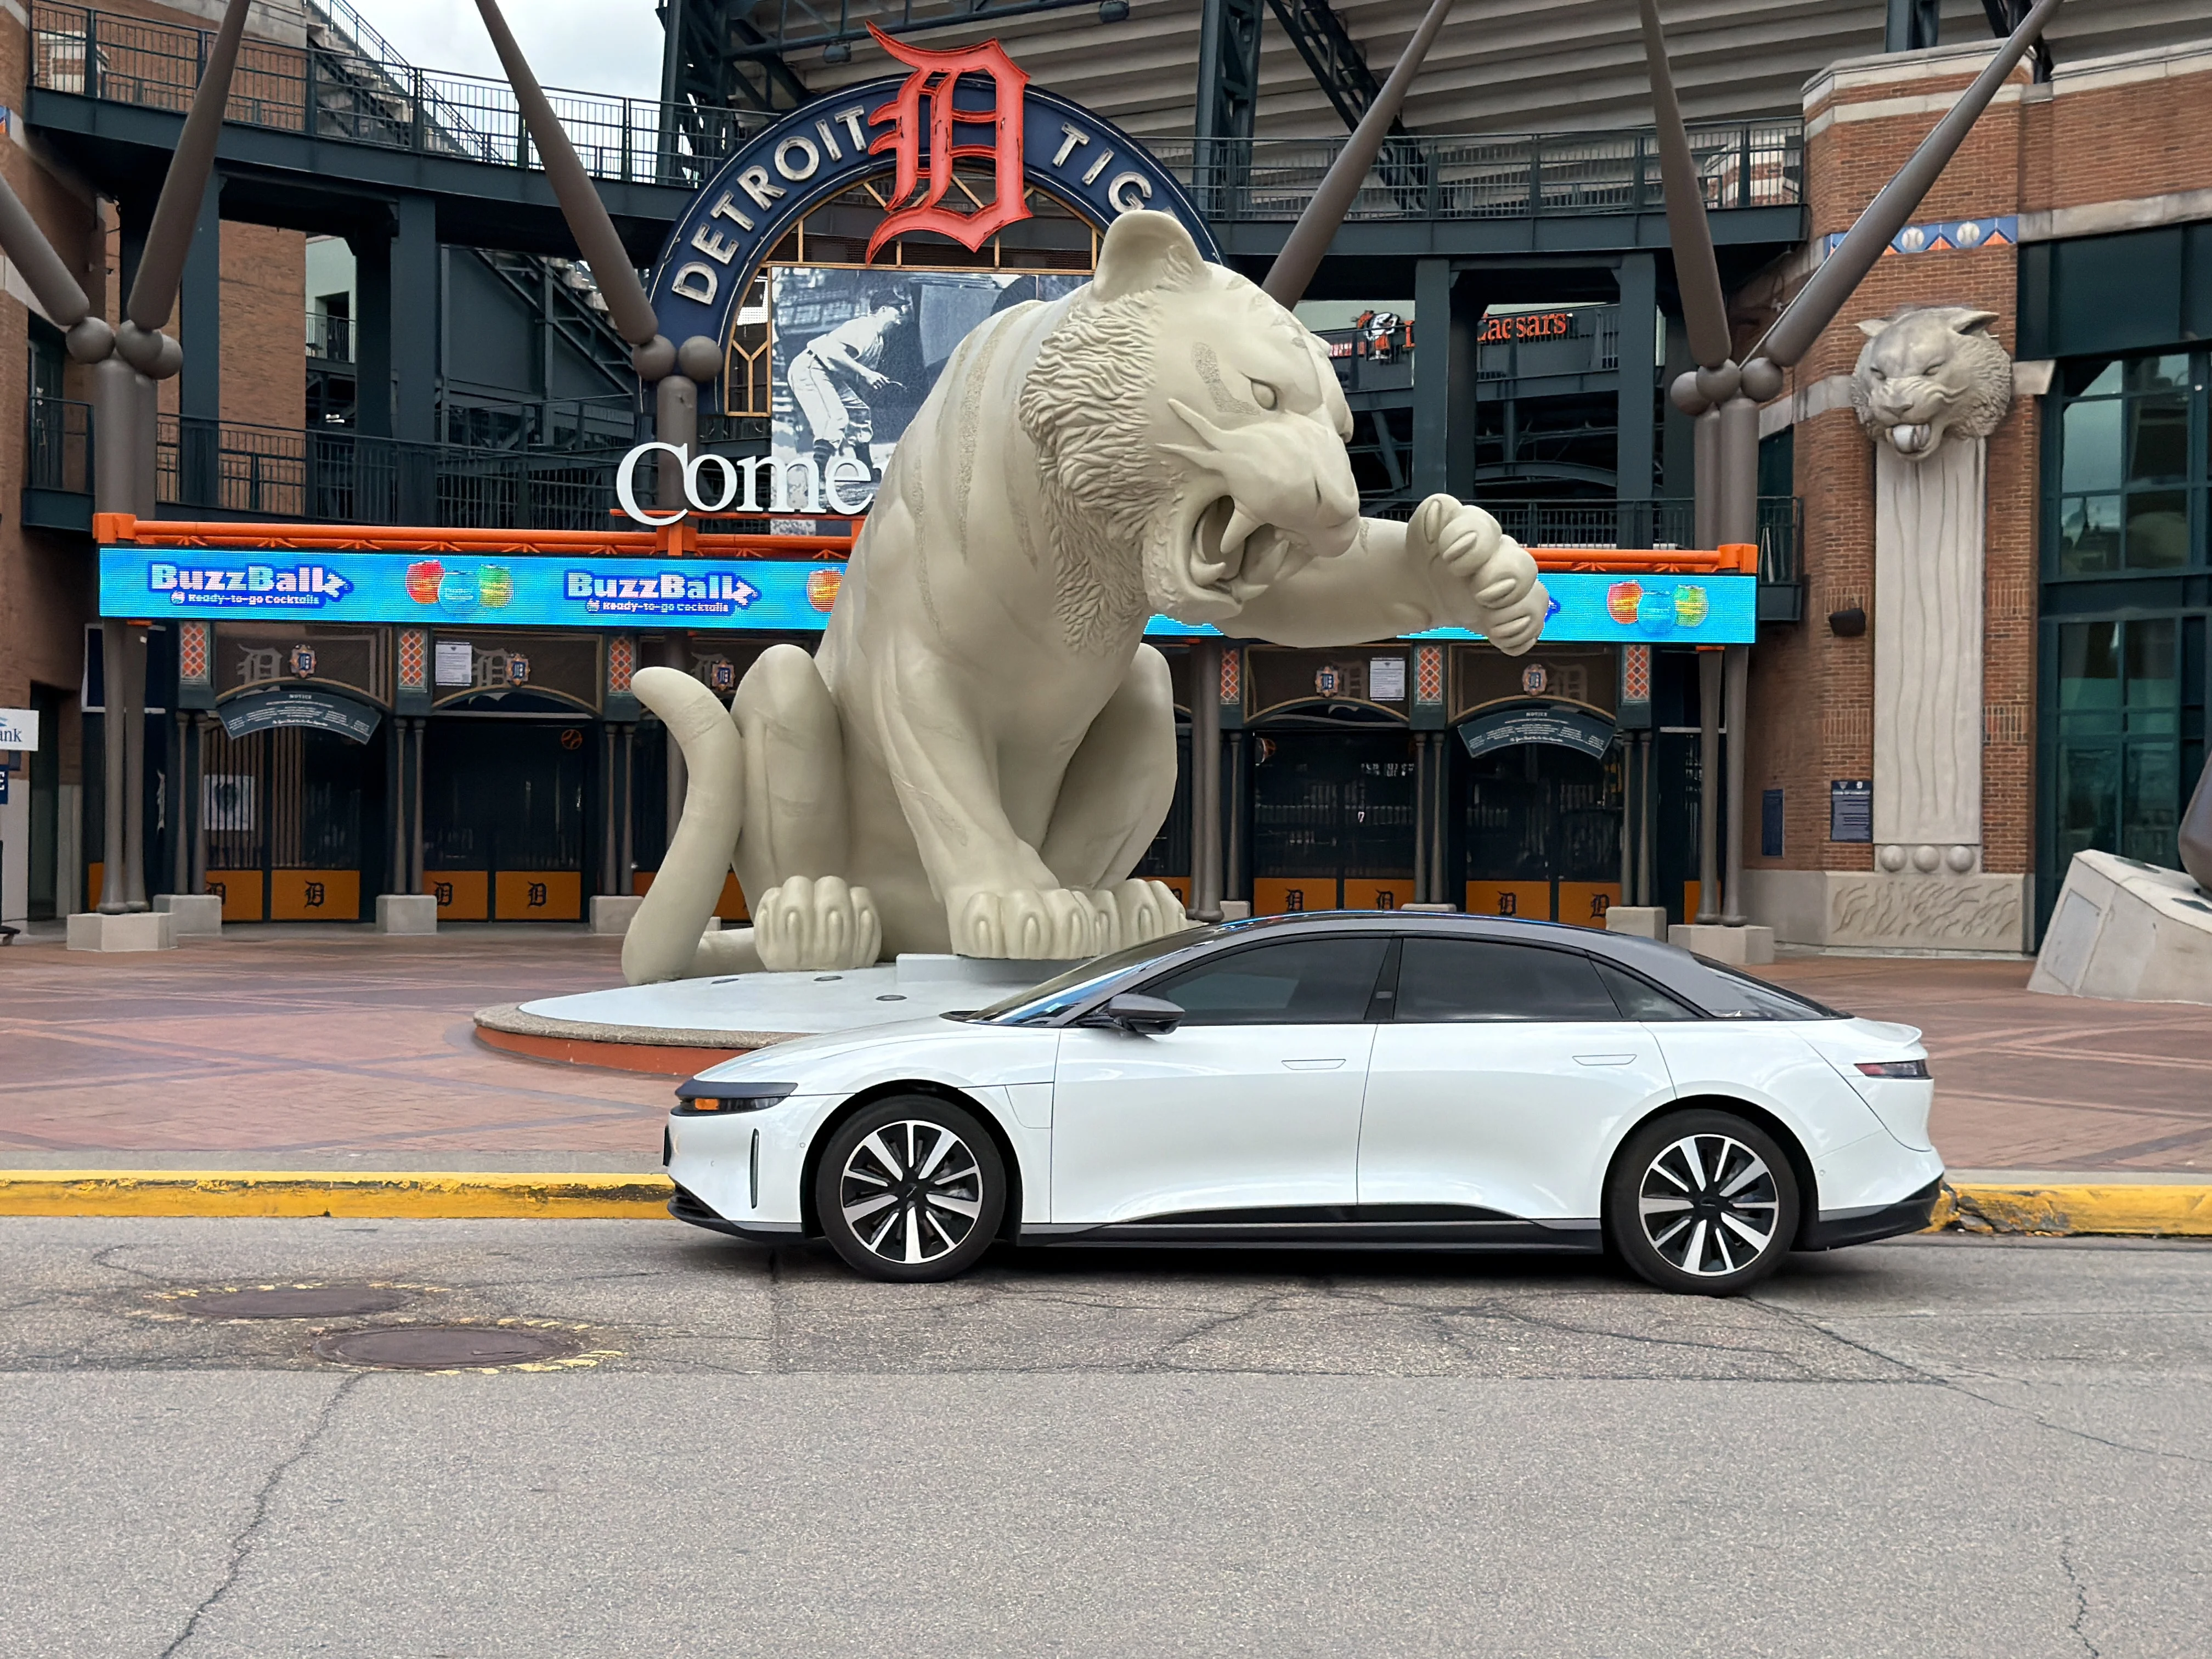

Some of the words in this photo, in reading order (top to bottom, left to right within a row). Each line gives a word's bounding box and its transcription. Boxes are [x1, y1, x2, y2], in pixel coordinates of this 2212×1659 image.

[672, 105, 867, 306] DETROIT
[1052, 122, 1177, 220] TIG
[616, 442, 882, 526] Come
[265, 595, 319, 604] Cocktails
